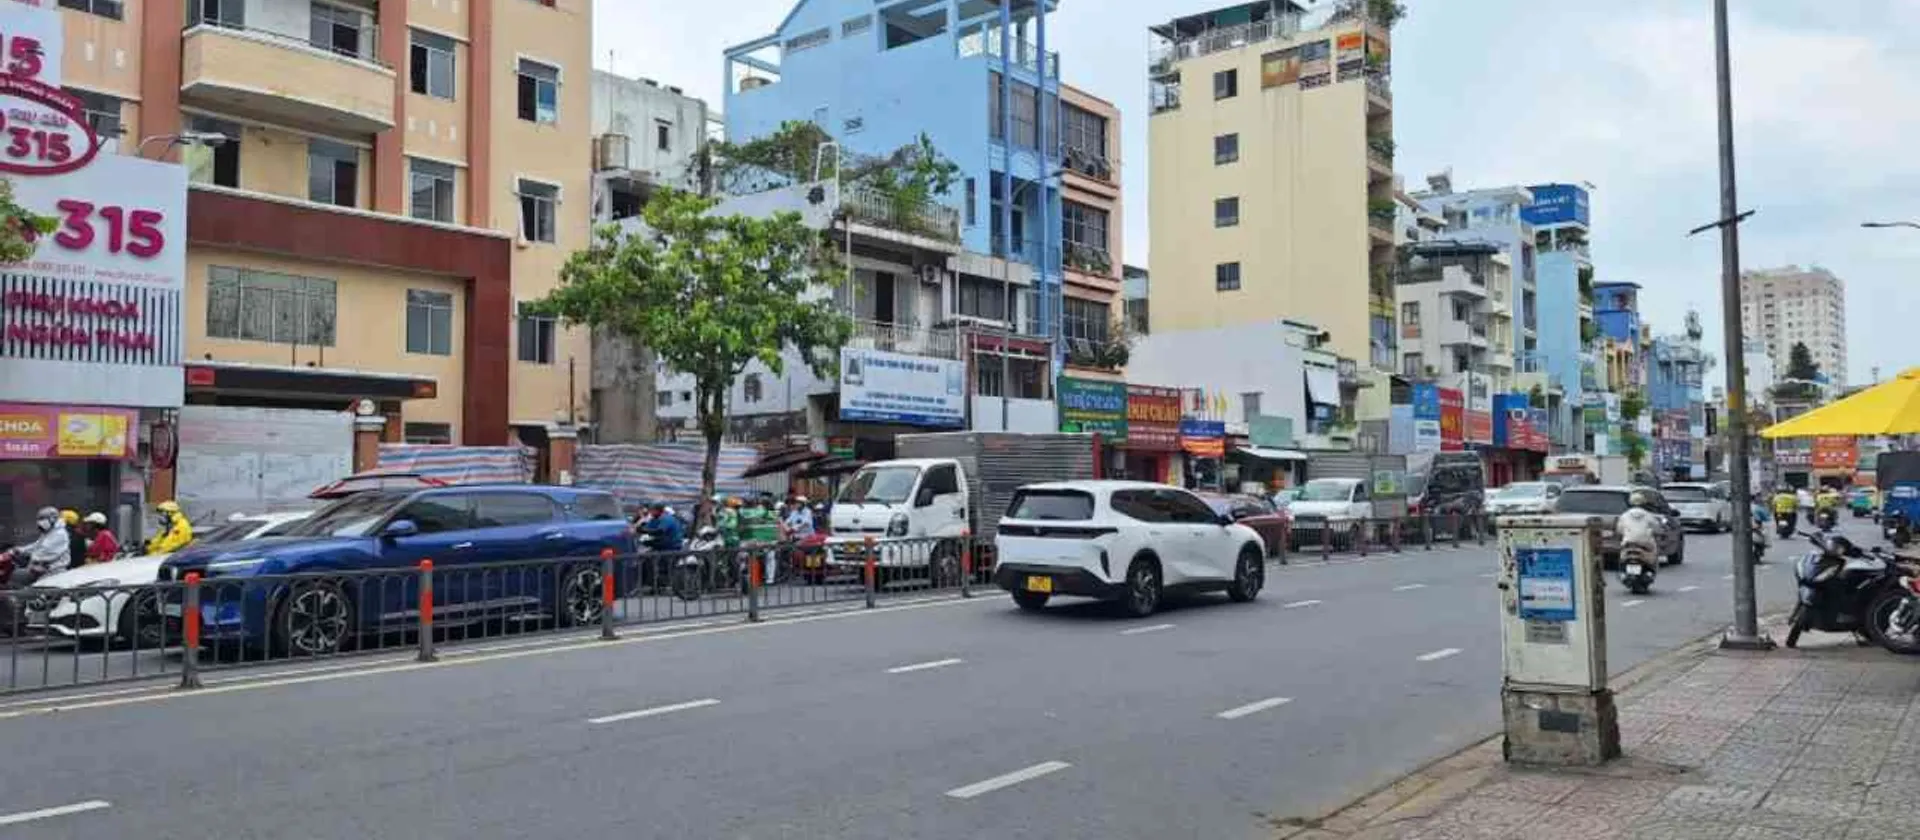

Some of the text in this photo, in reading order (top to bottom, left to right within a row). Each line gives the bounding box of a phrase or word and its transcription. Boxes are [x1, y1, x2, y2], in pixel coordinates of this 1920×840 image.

[6, 125, 72, 163] 315
[54, 199, 166, 258] 315
[67, 297, 139, 319] KHOA
[96, 328, 155, 350] THAI
